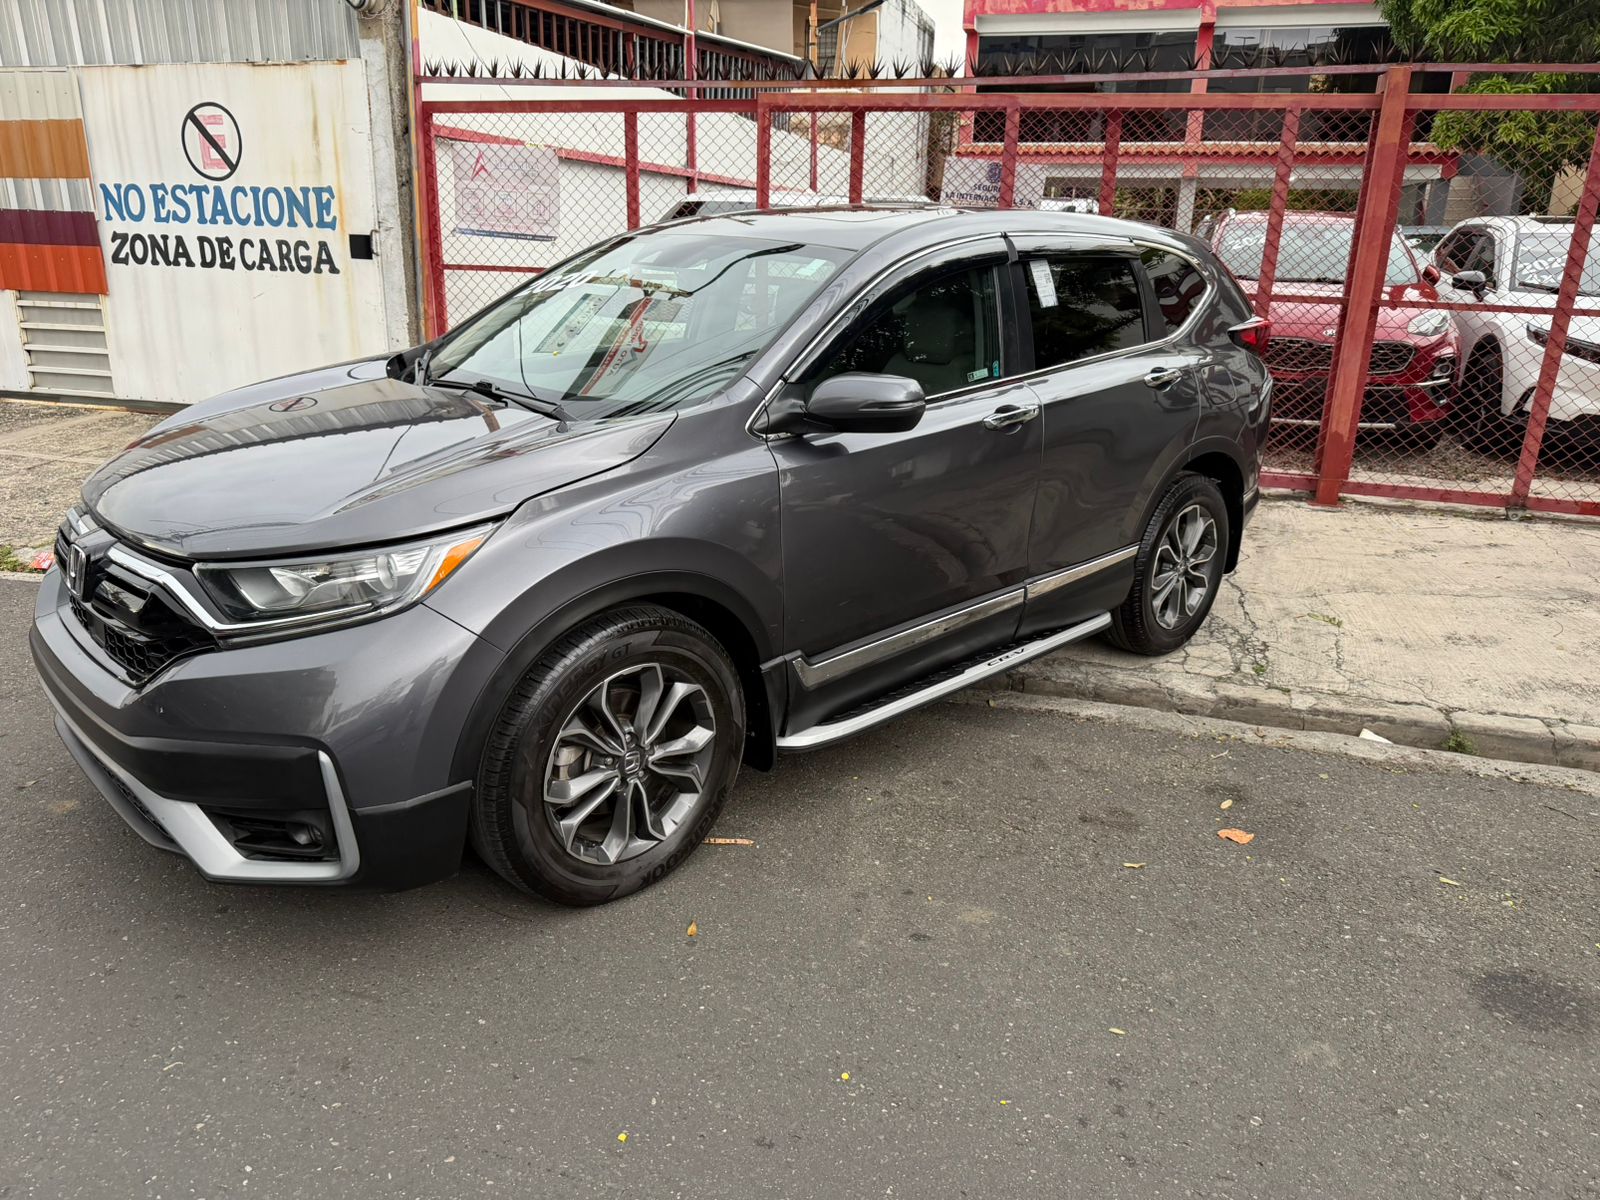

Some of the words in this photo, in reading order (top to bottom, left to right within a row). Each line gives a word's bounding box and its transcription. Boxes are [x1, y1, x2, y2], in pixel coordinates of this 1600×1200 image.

[99, 183, 146, 222] NO
[150, 182, 337, 231] ESTACIONE
[111, 230, 196, 268] ZONA
[197, 235, 236, 271] DE
[239, 238, 341, 275] CARGA
[611, 642, 633, 659] GT
[987, 648, 1025, 666] CR-V
